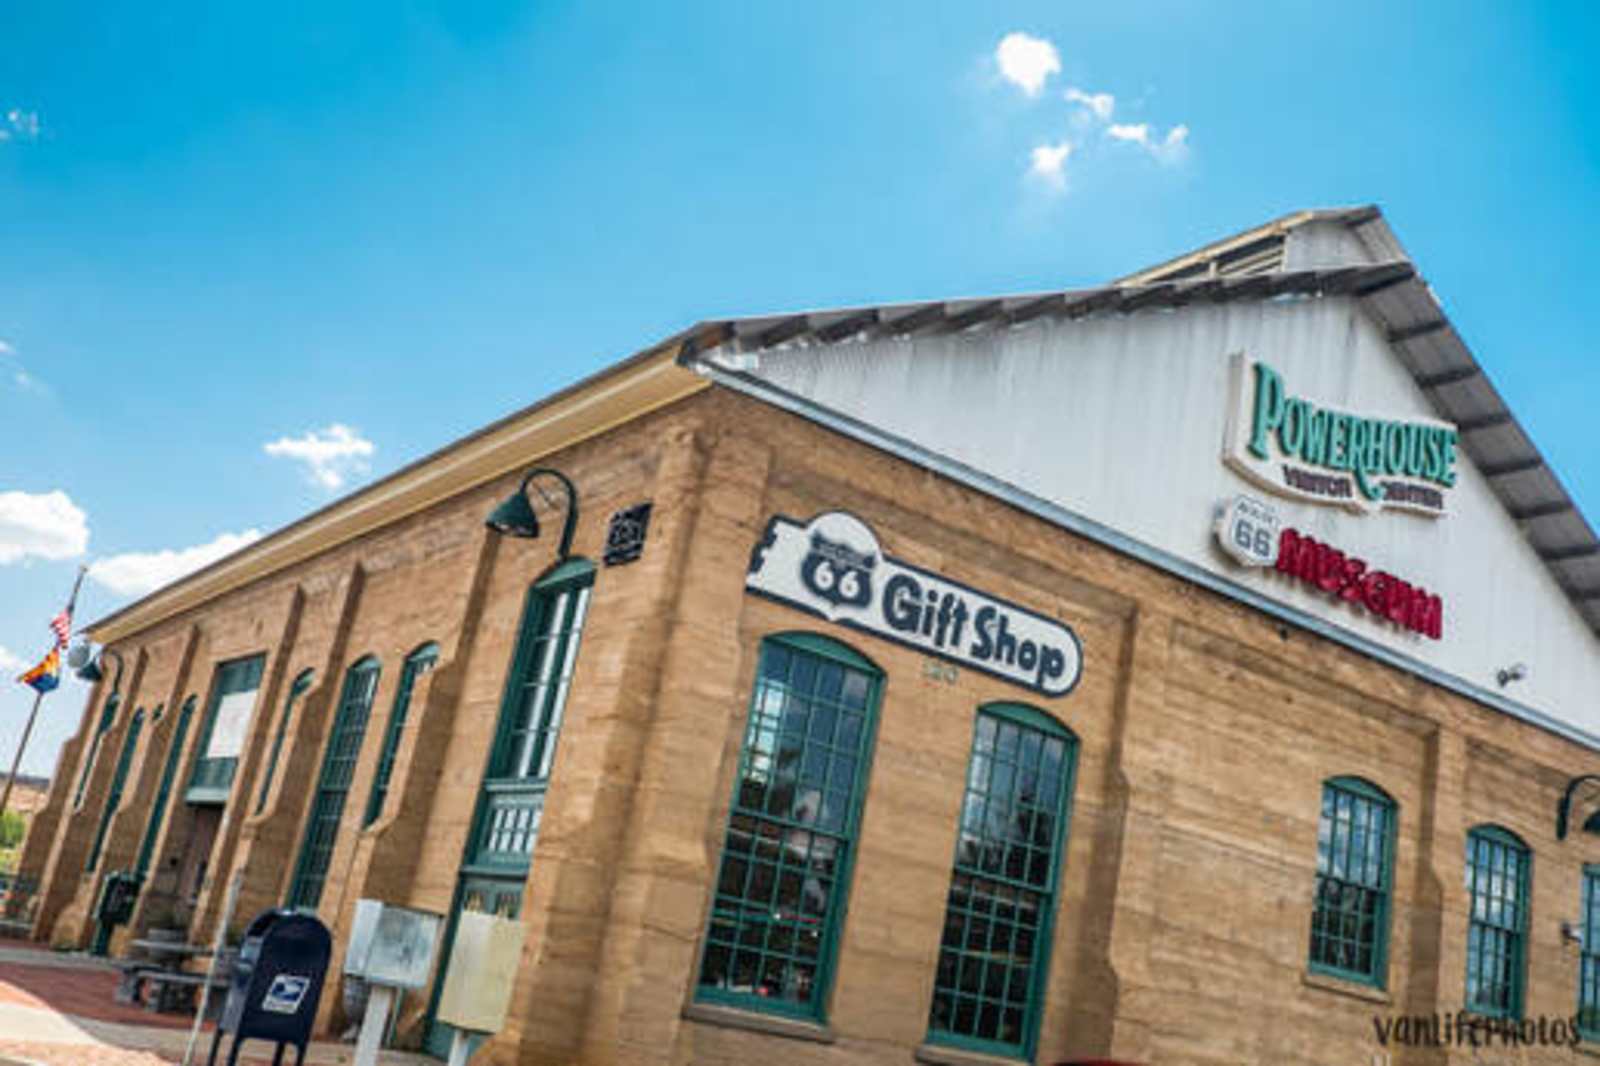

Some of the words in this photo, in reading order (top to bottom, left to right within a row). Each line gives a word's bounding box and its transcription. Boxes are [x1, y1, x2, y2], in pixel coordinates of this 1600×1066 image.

[1234, 519, 1270, 557] 66
[813, 561, 860, 599] 66
[882, 573, 969, 648] Gift
[971, 605, 1065, 686] Shop
